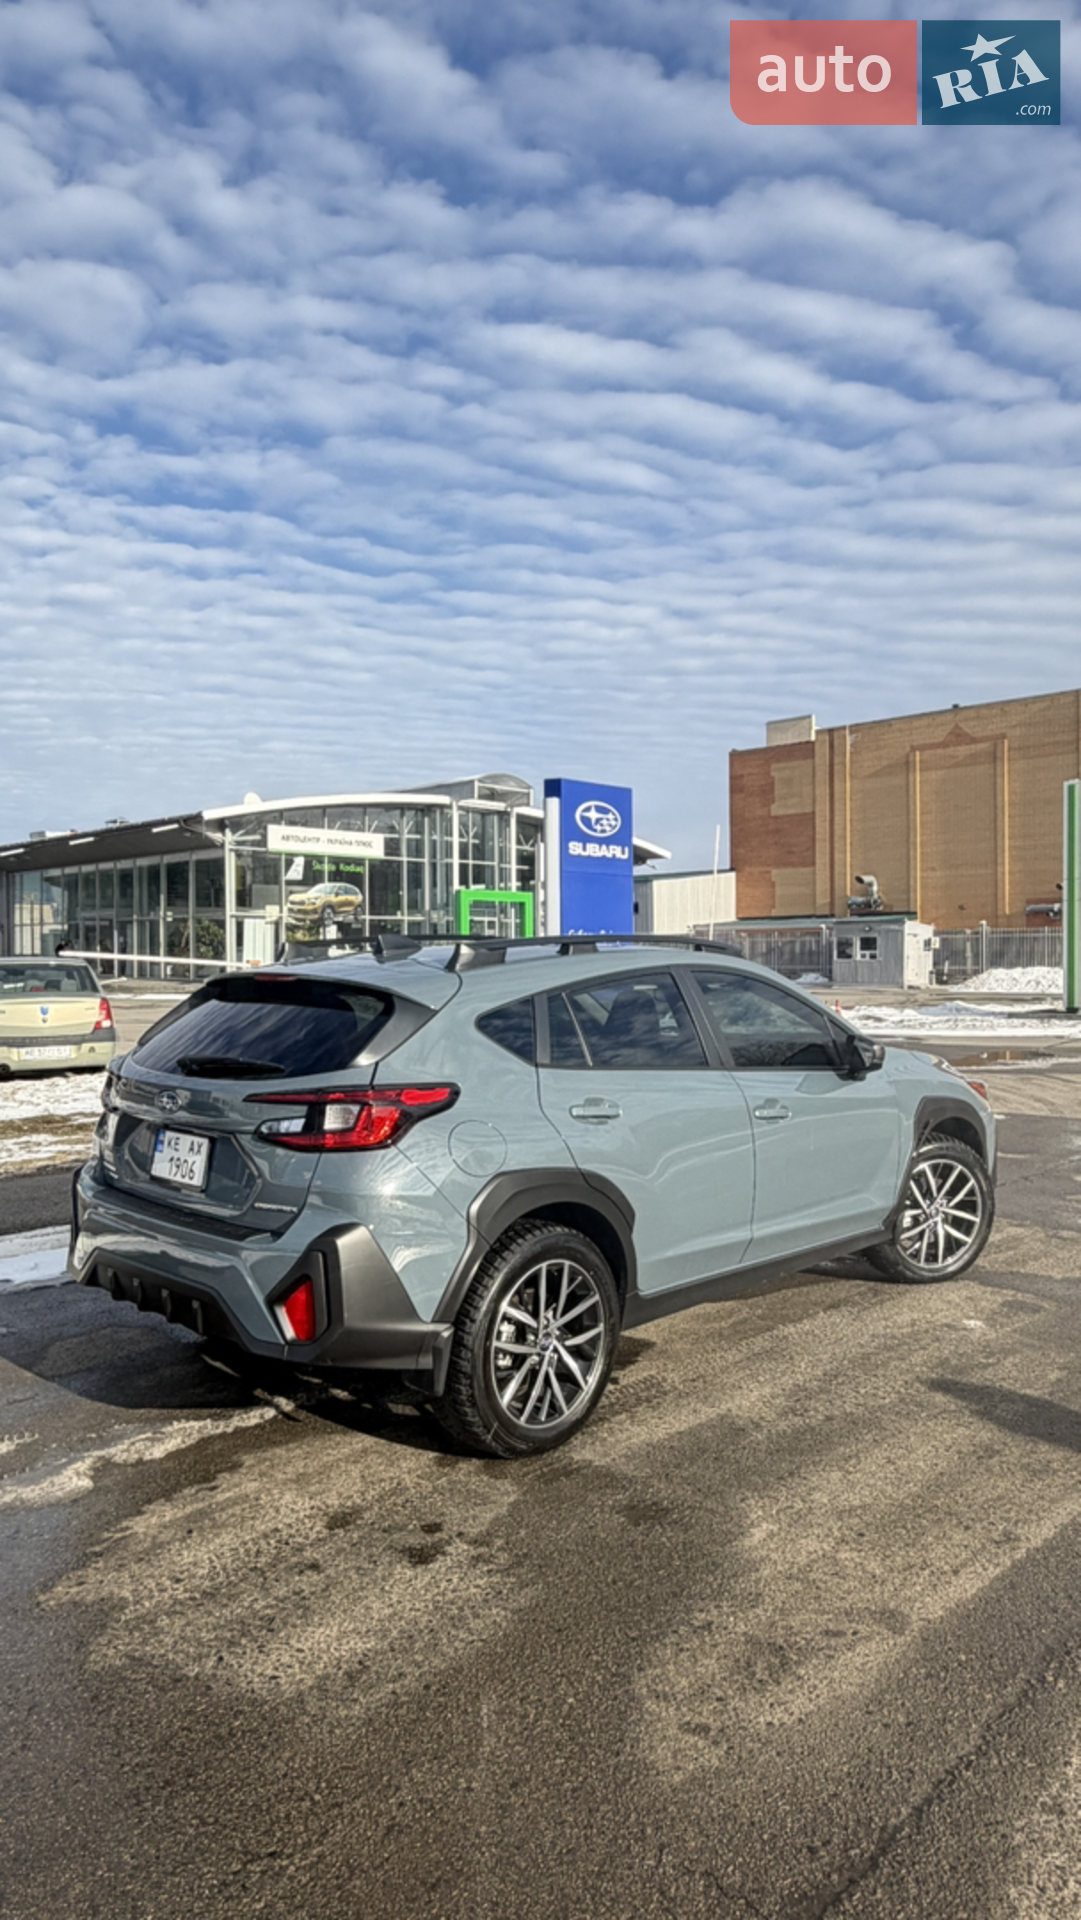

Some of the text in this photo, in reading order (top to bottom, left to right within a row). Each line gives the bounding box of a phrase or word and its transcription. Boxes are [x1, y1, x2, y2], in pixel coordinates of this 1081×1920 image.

[281, 834, 320, 845] АВТОЦЕНТР
[568, 841, 629, 860] SUBARU
[167, 1136, 203, 1156] KE AX
[168, 1156, 196, 1181] 1906
